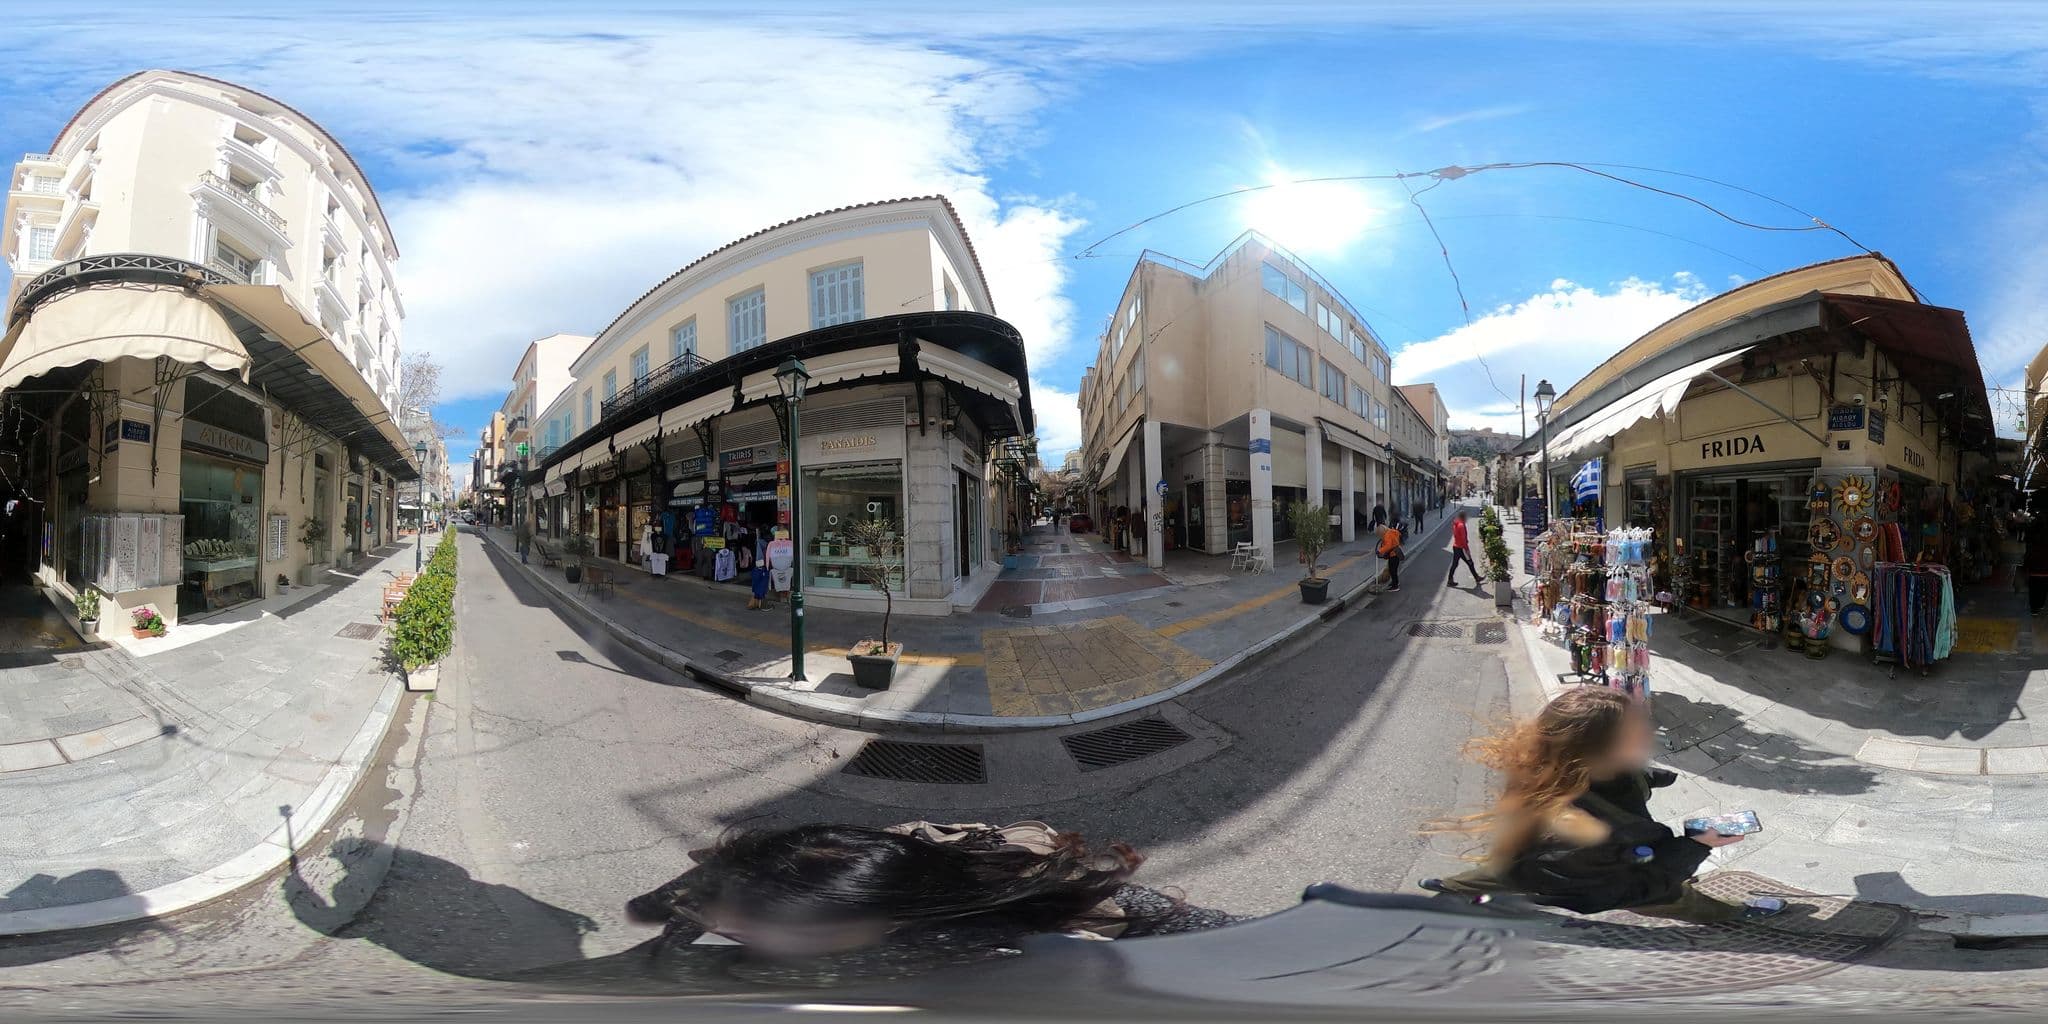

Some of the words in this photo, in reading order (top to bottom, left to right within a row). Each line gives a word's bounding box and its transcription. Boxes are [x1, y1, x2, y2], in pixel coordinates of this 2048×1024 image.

[820, 435, 877, 449] PANAIDIS
[1702, 434, 1766, 460] FRIDA
[1903, 446, 1925, 471] FRIDA
